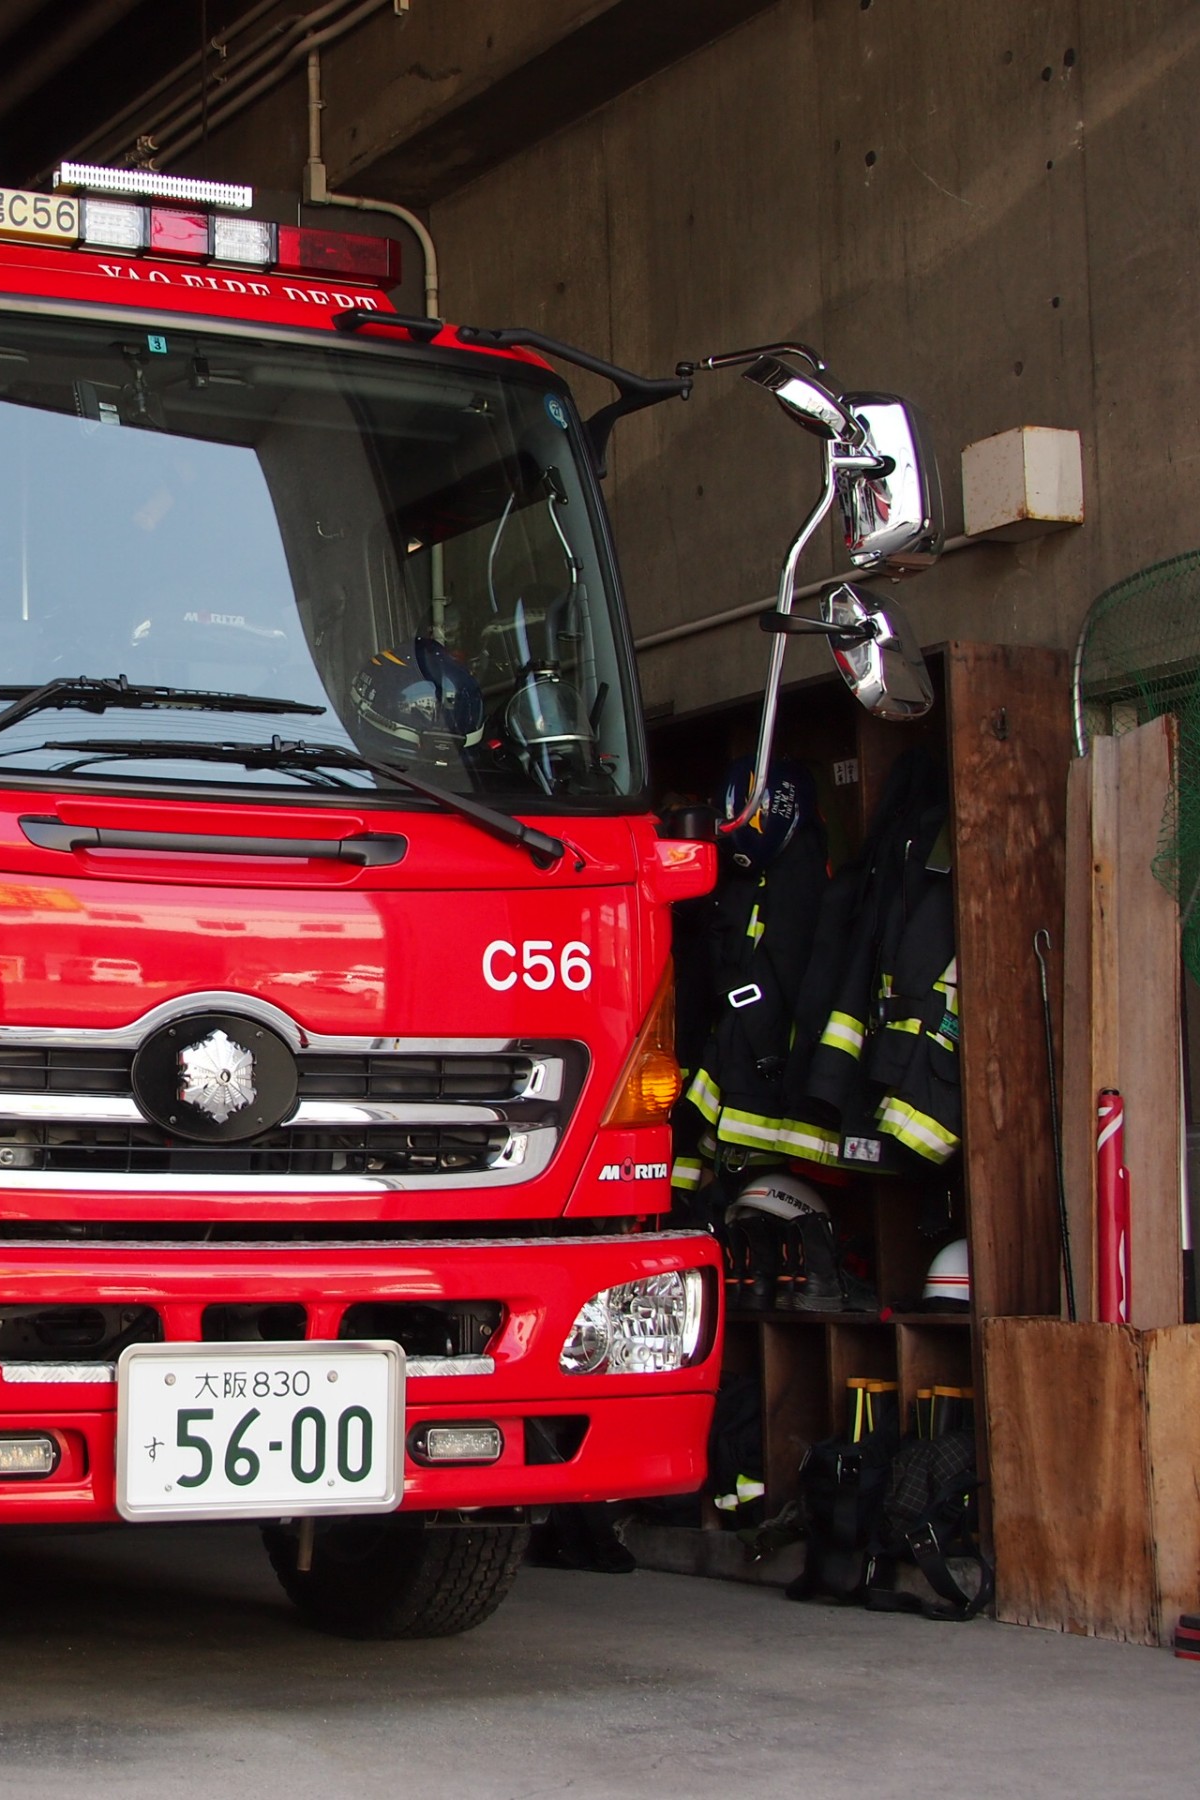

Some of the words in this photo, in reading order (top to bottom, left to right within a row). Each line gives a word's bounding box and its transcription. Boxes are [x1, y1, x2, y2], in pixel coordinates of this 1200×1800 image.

[482, 939, 593, 992] C56
[597, 1156, 668, 1182] MORITA
[144, 1436, 165, 1463] す
[175, 1404, 373, 1488] 56-00
